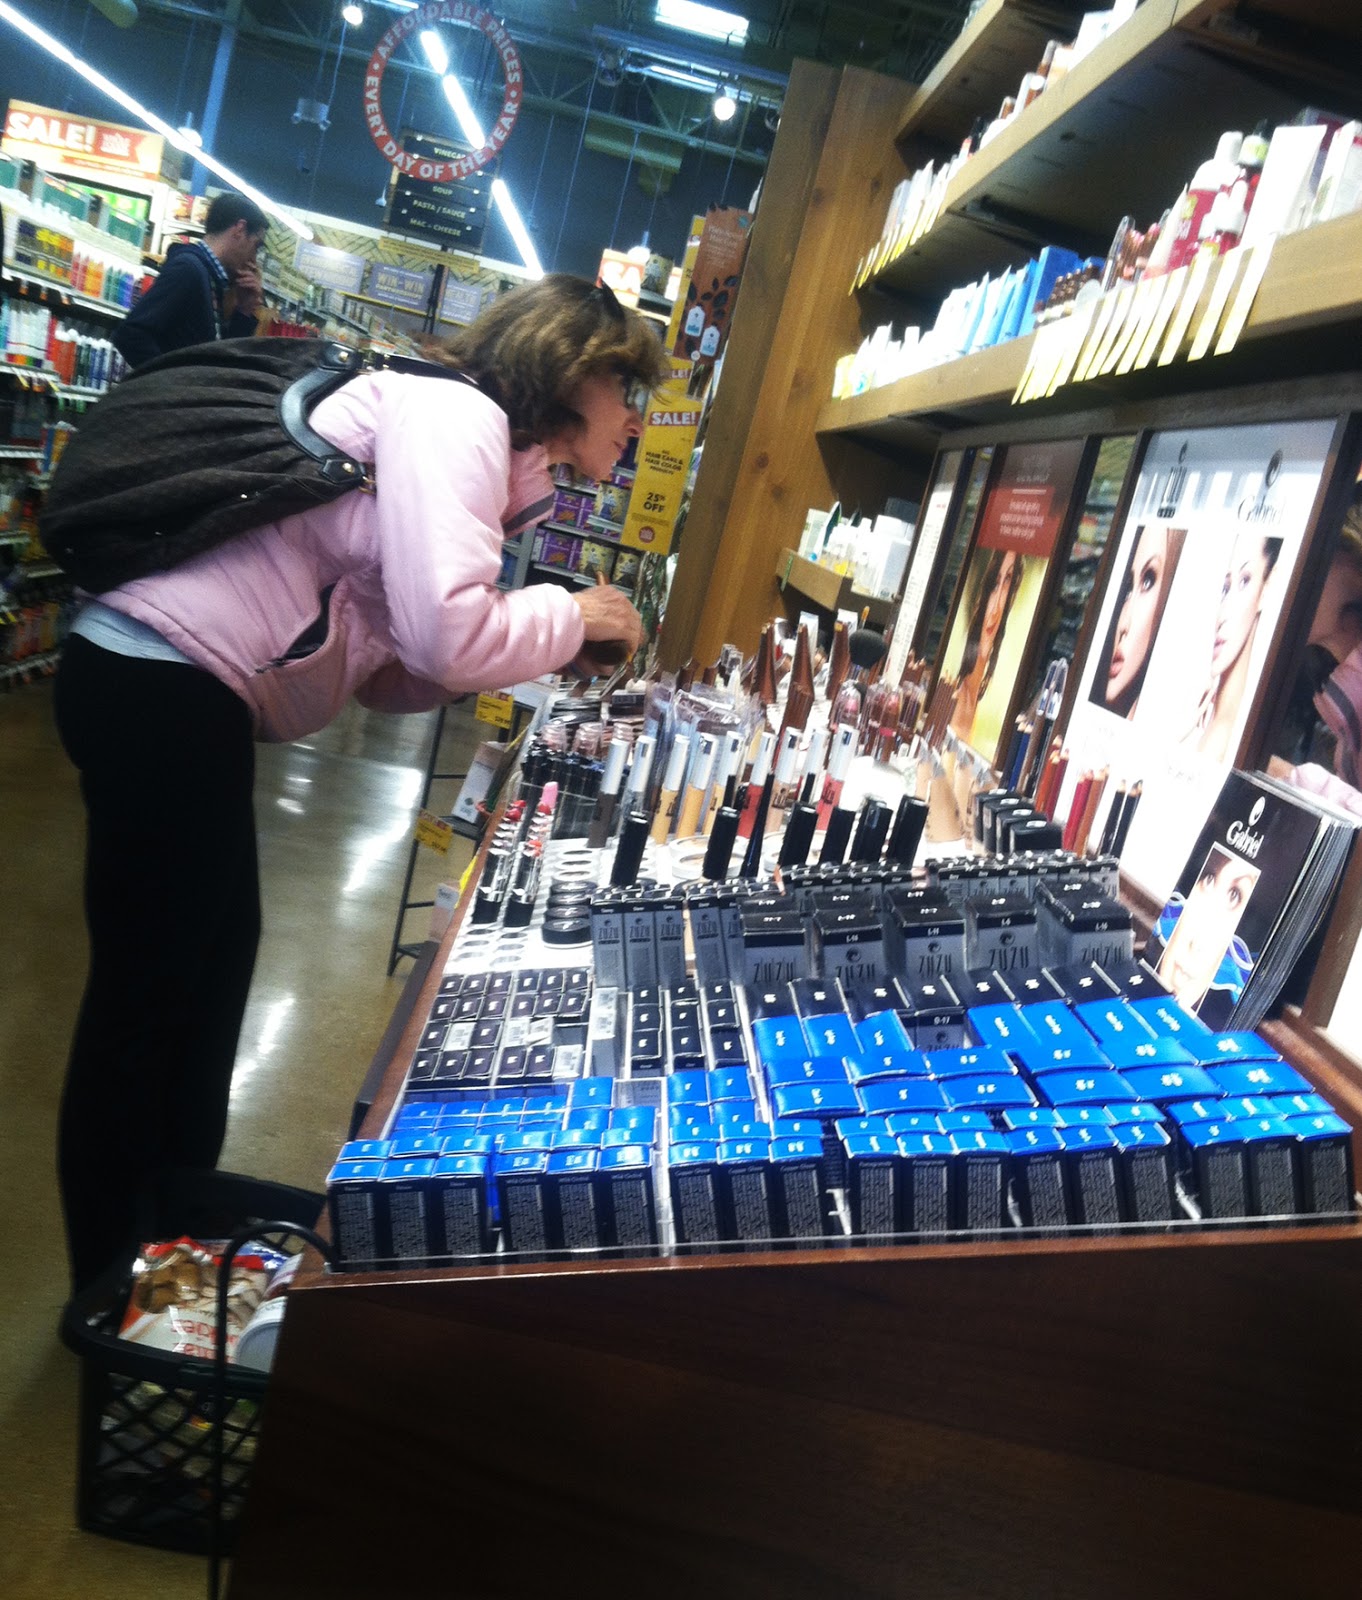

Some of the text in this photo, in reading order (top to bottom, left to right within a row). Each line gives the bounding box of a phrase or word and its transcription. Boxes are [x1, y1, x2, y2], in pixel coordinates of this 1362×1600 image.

[377, 2, 522, 85] AFFORDABLE PRICES
[8, 111, 97, 155] SALE!
[365, 75, 519, 180] EVERY DAY OF THE YEAR
[432, 185, 454, 196] SOUP
[412, 199, 436, 212] PASTA
[442, 206, 467, 219] SAUCE
[409, 217, 427, 229] MAC
[433, 223, 462, 237] CHEESE
[651, 411, 696, 426] SALE!
[643, 501, 665, 513] OFF
[1226, 819, 1265, 860] Gabriel
